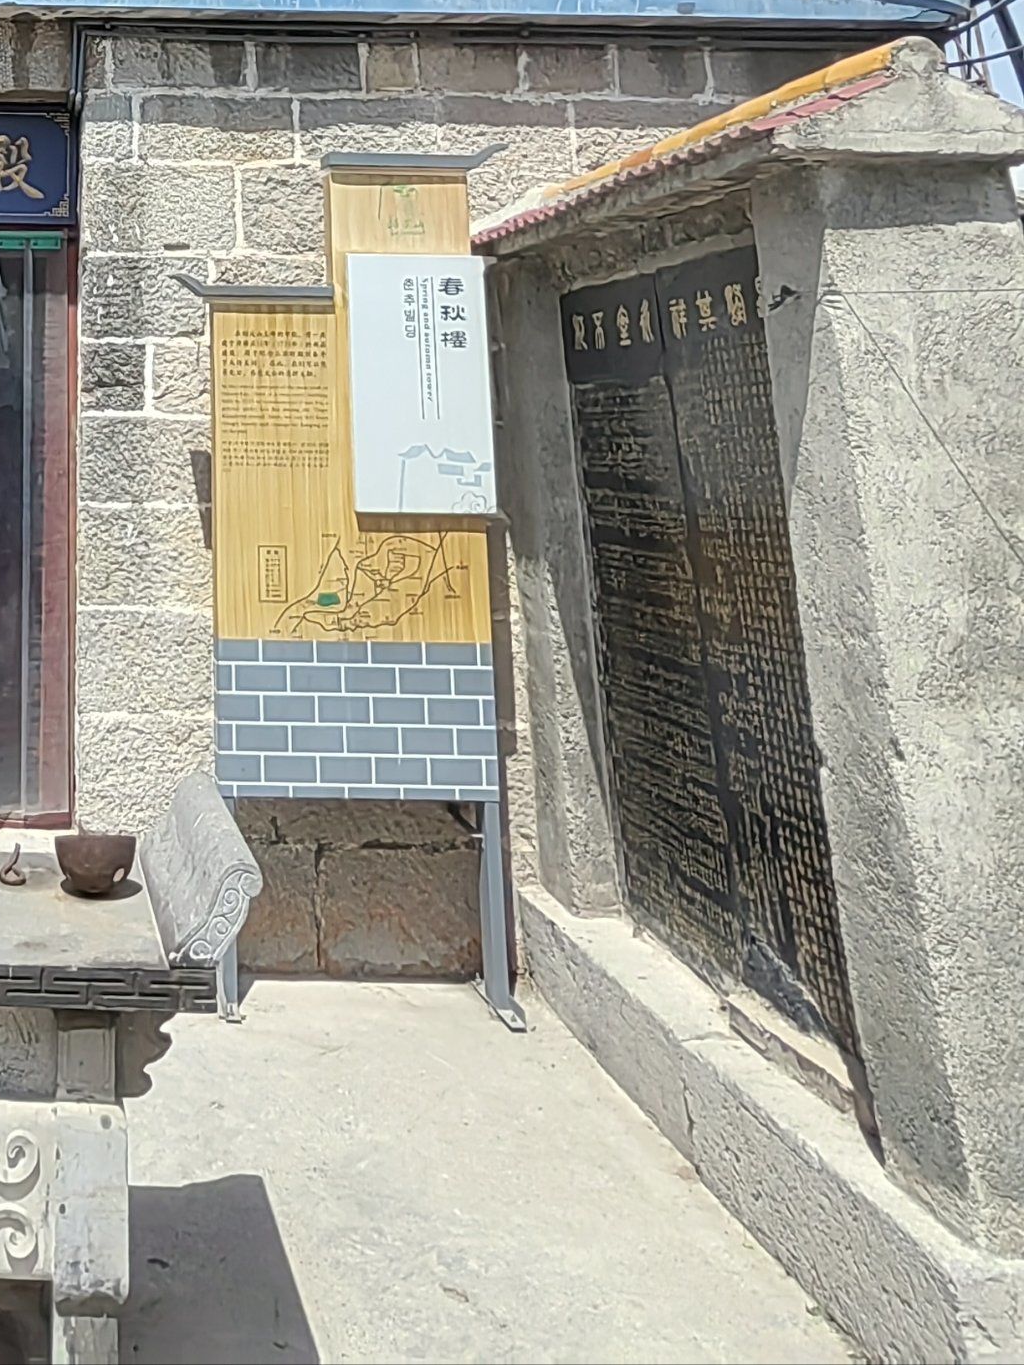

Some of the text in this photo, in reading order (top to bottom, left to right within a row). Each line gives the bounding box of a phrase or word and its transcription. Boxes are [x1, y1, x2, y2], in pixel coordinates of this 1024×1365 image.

[423, 312, 431, 330] and
[438, 277, 467, 349] 春秋樓
